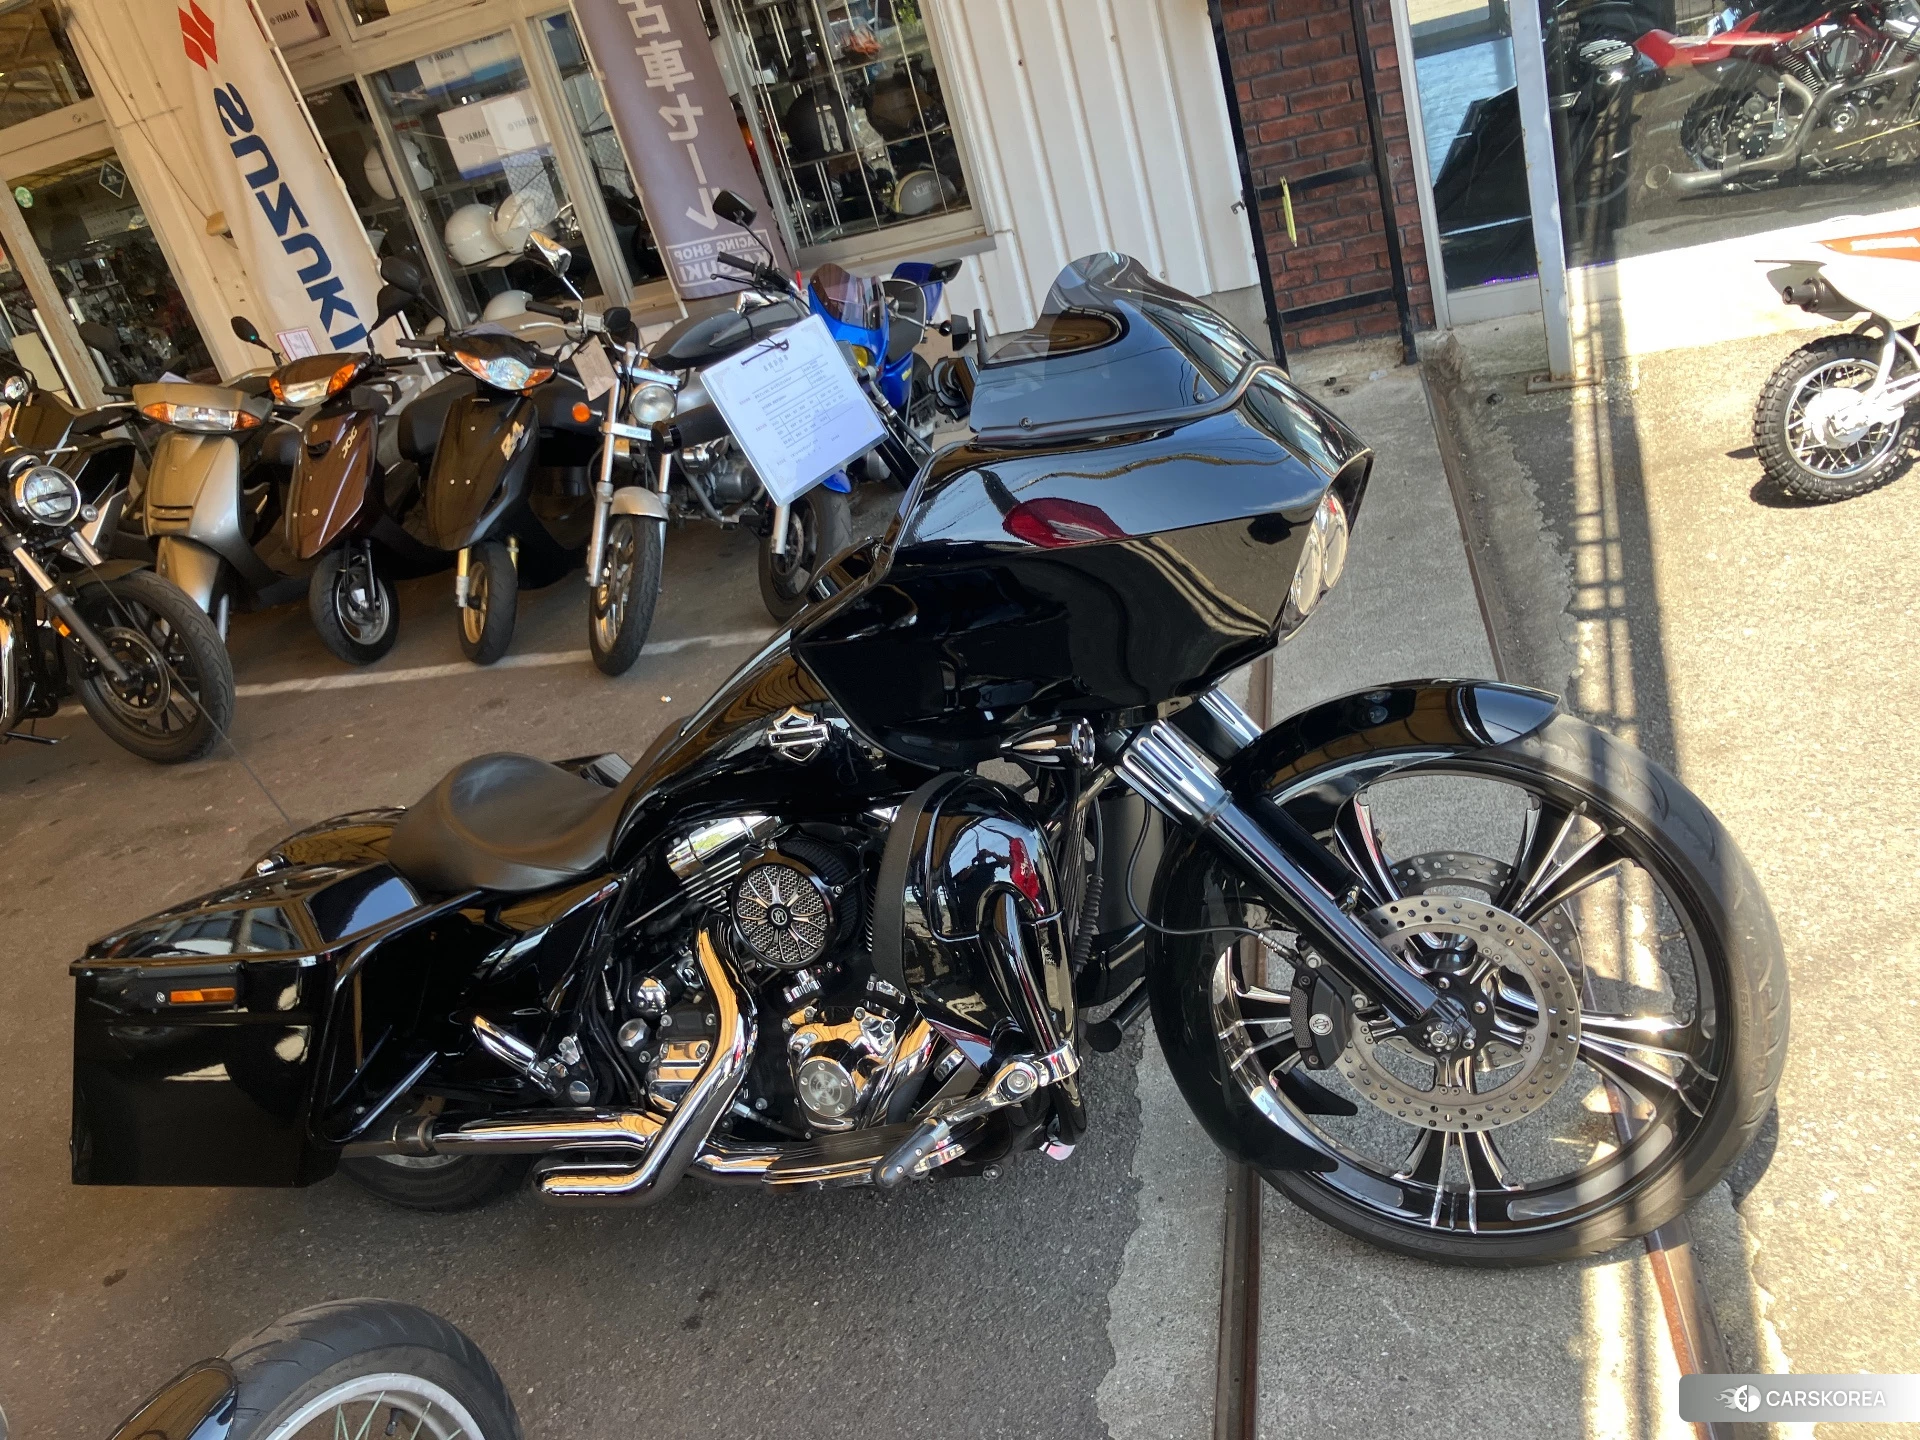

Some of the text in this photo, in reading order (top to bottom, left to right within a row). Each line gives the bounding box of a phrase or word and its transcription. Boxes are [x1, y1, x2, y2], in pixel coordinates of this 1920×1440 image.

[275, 9, 299, 24] YAMAHA
[464, 128, 491, 143] YAMAHA
[341, 425, 358, 459] JOG
